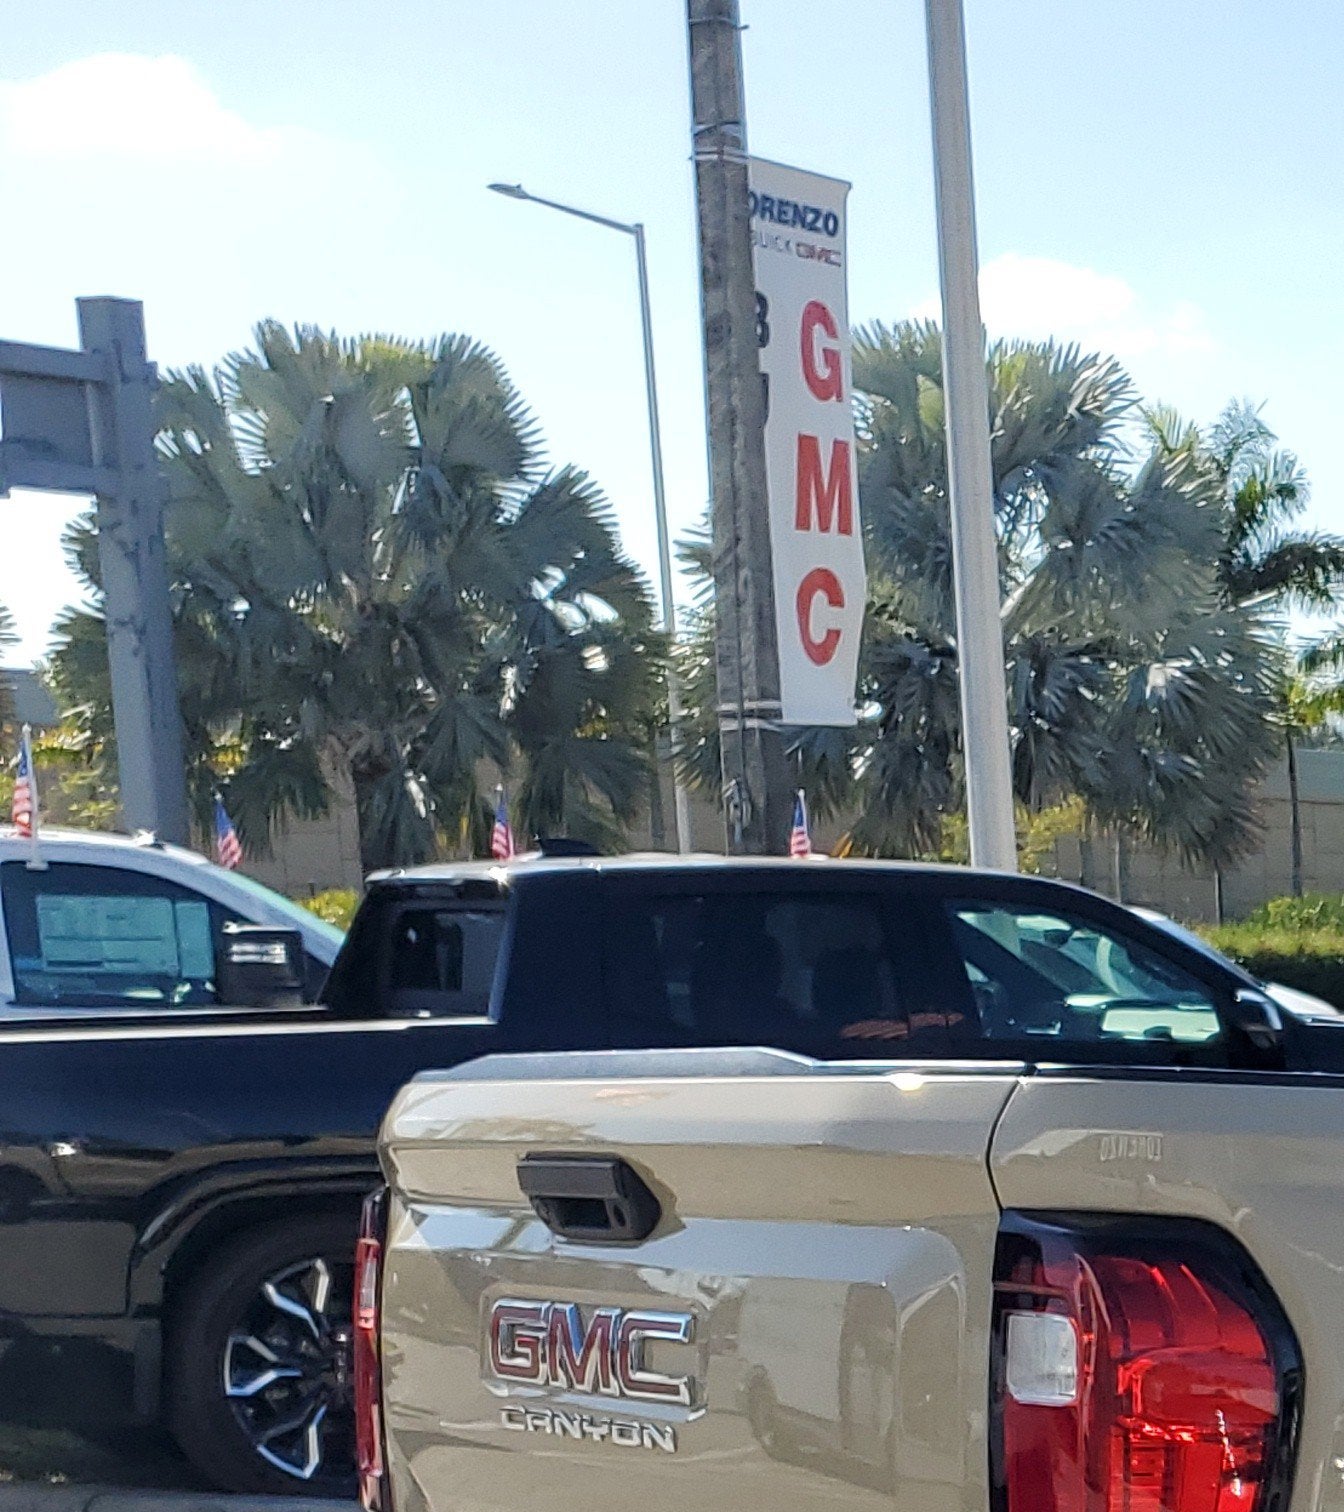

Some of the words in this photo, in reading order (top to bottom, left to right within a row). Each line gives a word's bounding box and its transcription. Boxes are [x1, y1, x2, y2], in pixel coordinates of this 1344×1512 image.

[796, 242, 842, 267] GMC
[491, 1298, 692, 1406] GMC
[499, 1404, 677, 1454] CANYON
